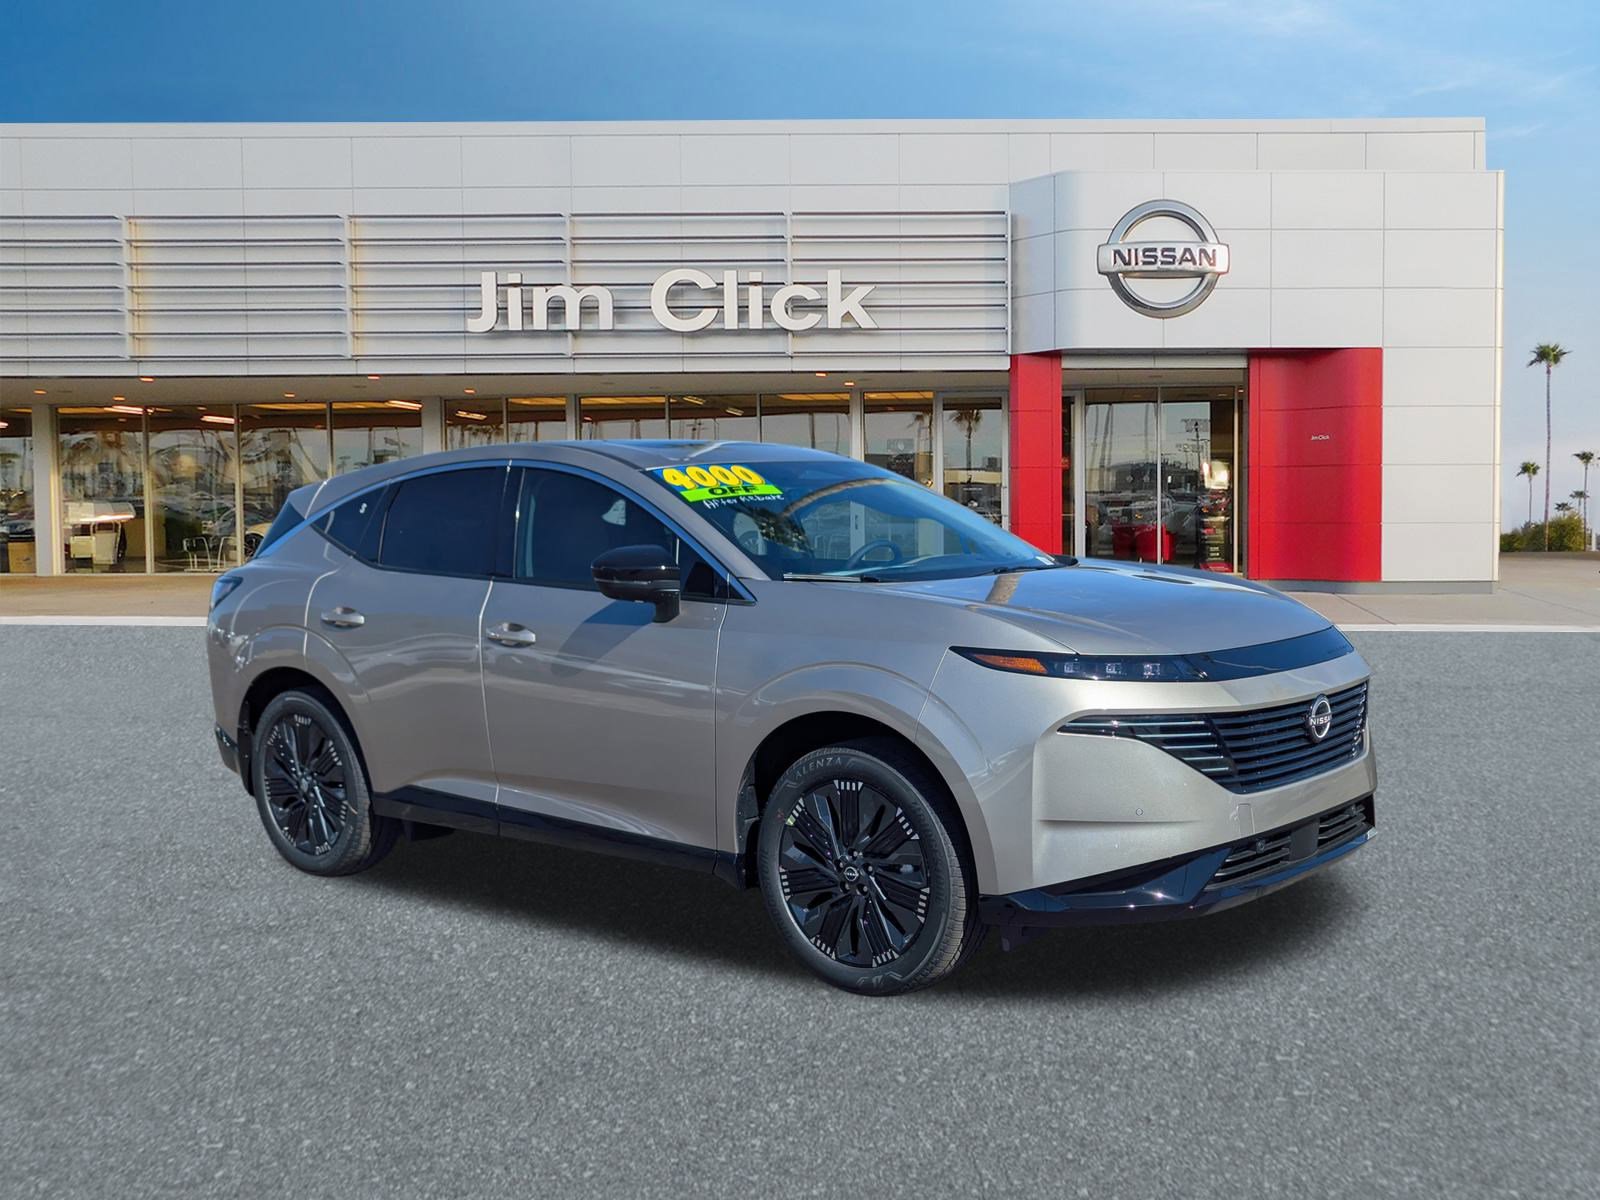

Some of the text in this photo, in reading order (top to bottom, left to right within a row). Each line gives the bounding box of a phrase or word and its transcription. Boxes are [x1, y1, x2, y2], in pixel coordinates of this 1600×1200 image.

[1113, 247, 1217, 267] NISSAN
[467, 268, 880, 333] Jim Click
[662, 464, 766, 490] 4000
[708, 485, 758, 496] OFF
